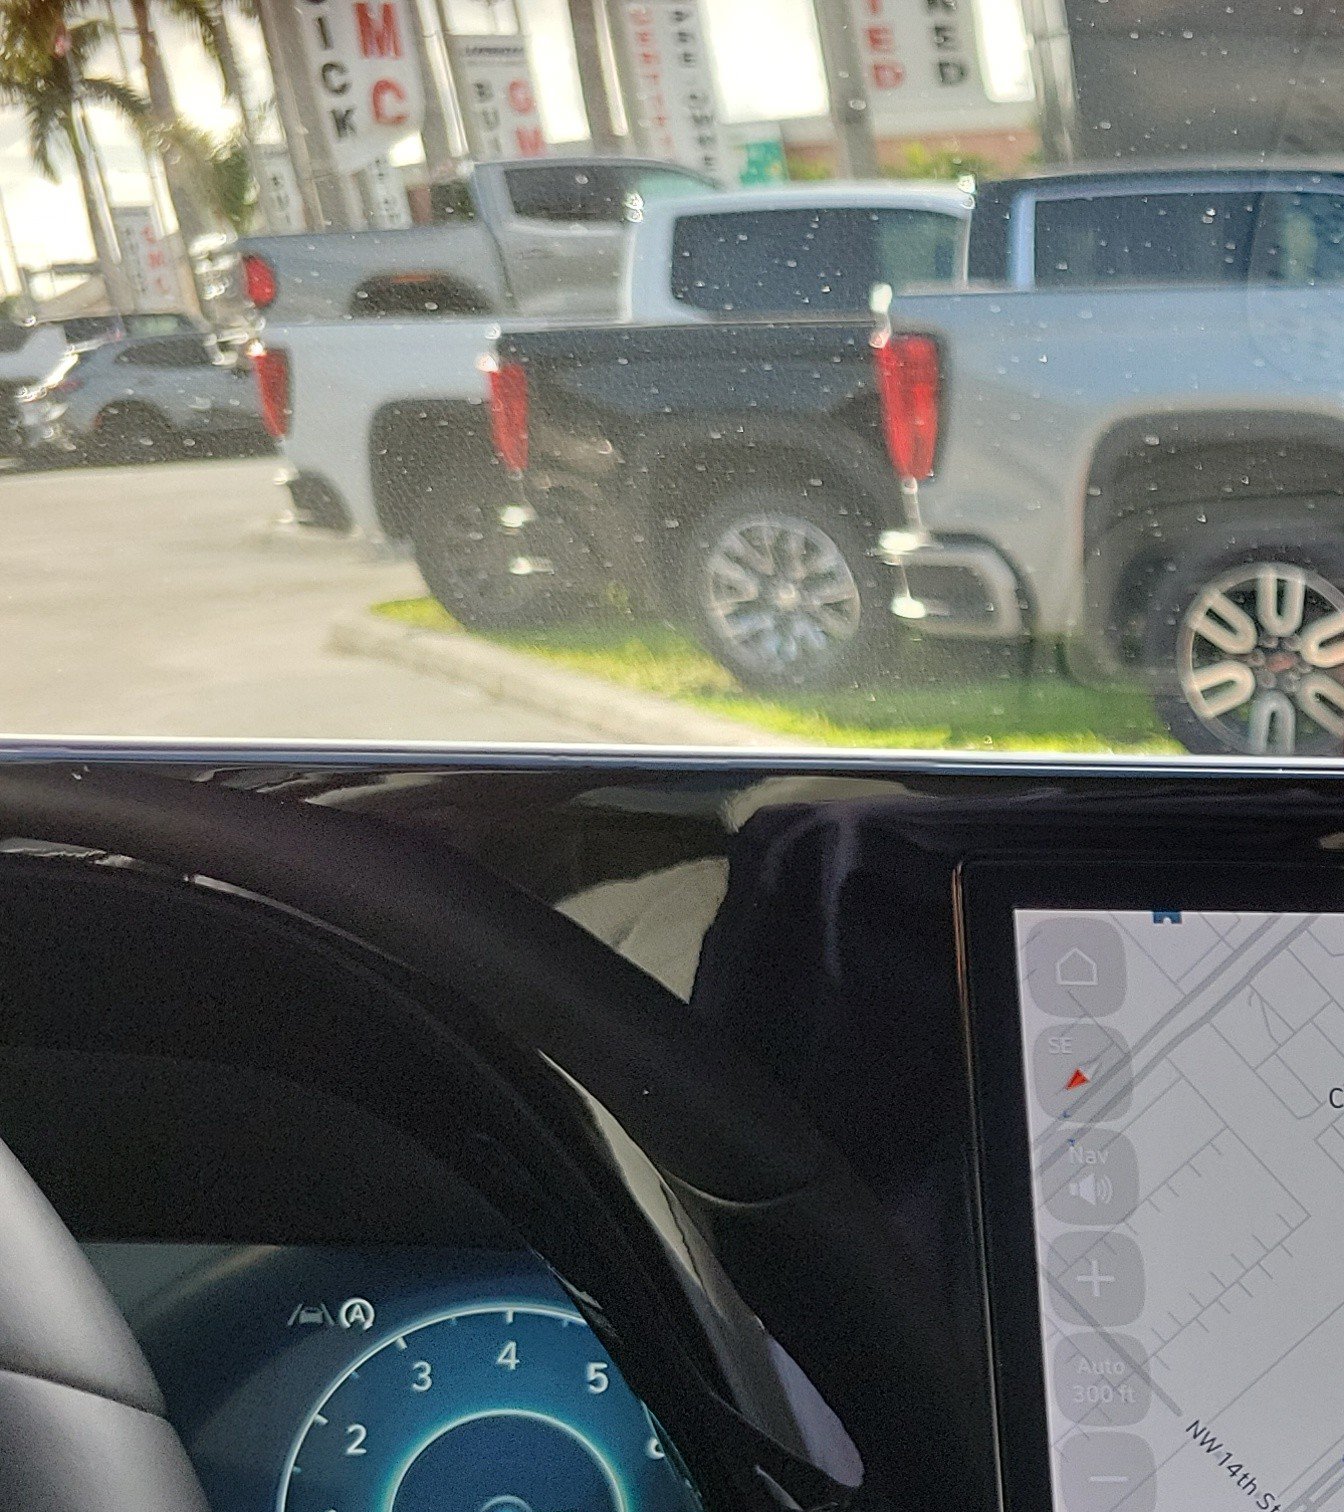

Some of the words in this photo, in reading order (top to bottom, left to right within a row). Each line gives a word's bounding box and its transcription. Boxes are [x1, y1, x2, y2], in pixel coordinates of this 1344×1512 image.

[314, 0, 358, 139] ICK
[496, 1340, 520, 1370] 4
[411, 1362, 433, 1391] 3
[586, 1363, 609, 1394] 5
[345, 1426, 368, 1455] 2
[1185, 1418, 1220, 1457] NW
[1219, 1451, 1260, 1495] 14th
